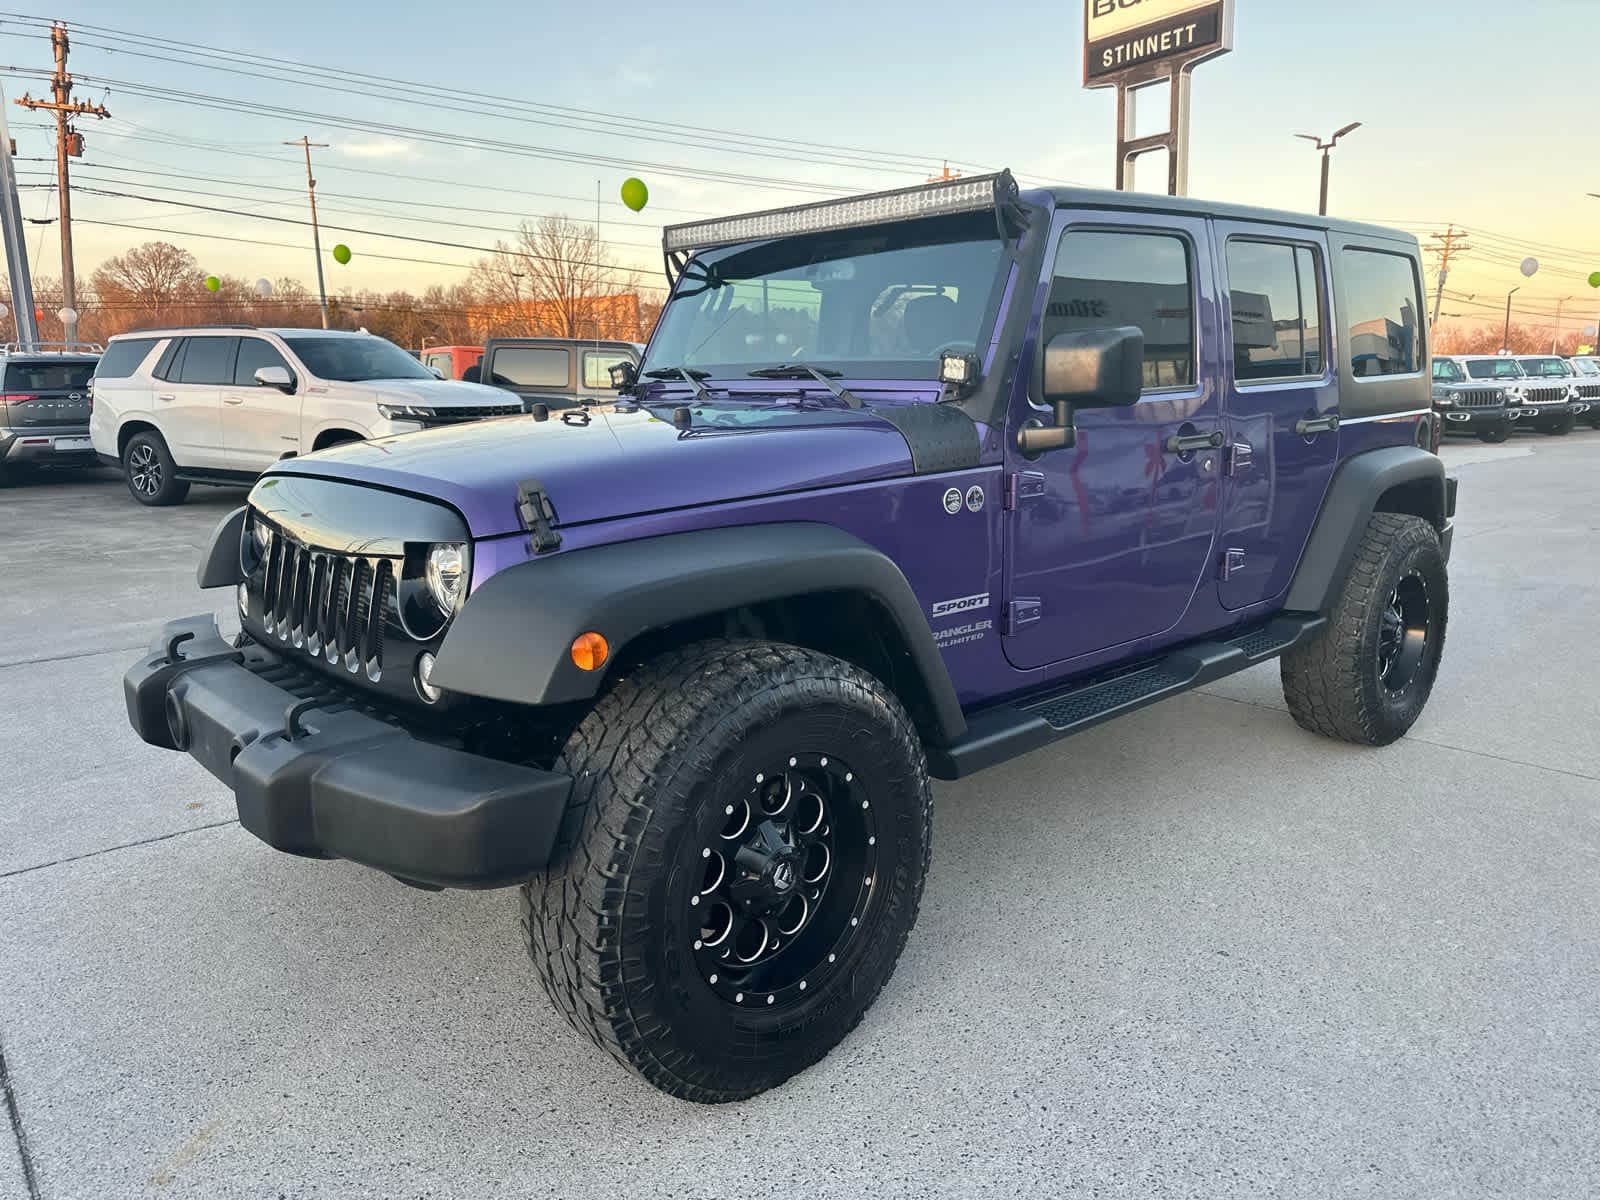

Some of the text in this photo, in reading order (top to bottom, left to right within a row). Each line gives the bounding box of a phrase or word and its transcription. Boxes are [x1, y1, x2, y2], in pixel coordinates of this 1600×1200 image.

[1103, 24, 1197, 67] STINNETT
[935, 598, 988, 614] SPORT
[932, 620, 992, 639] RANGLER
[936, 632, 984, 649] NLIMITED
